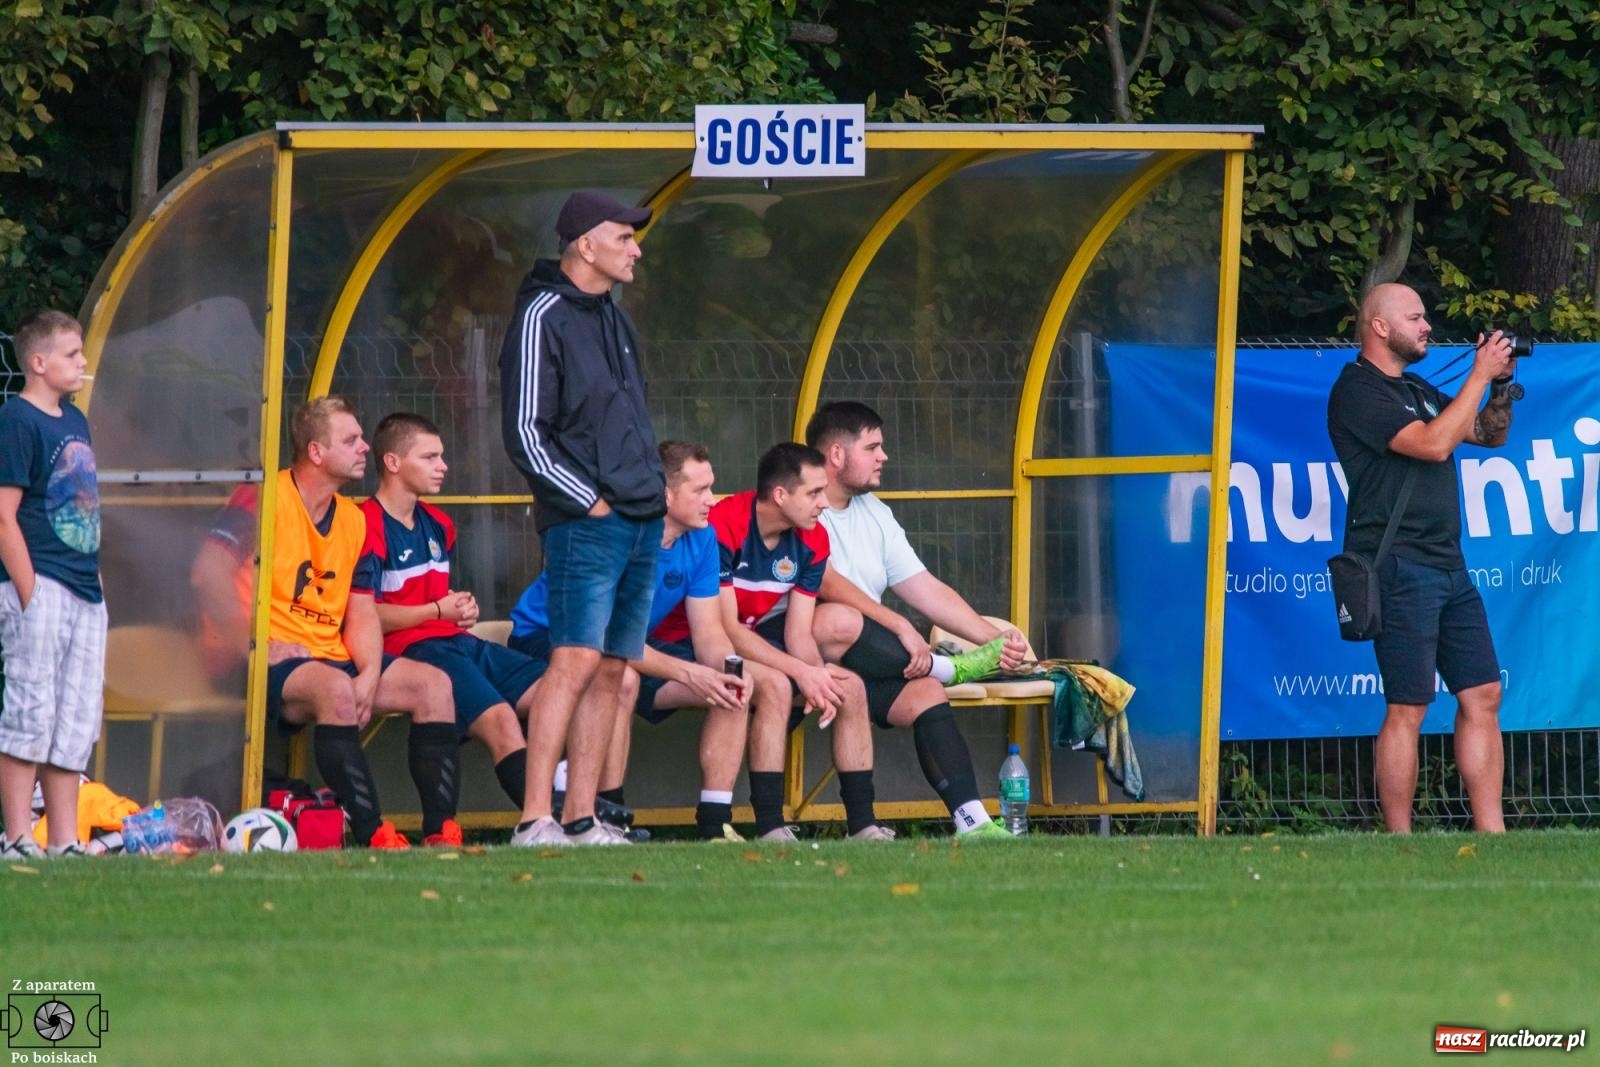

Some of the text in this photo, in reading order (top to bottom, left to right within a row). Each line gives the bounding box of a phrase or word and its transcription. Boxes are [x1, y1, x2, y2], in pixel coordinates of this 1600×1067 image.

[708, 110, 854, 165] GOŚCIE
[1225, 567, 1287, 593] tudio
[1521, 559, 1562, 586] druk
